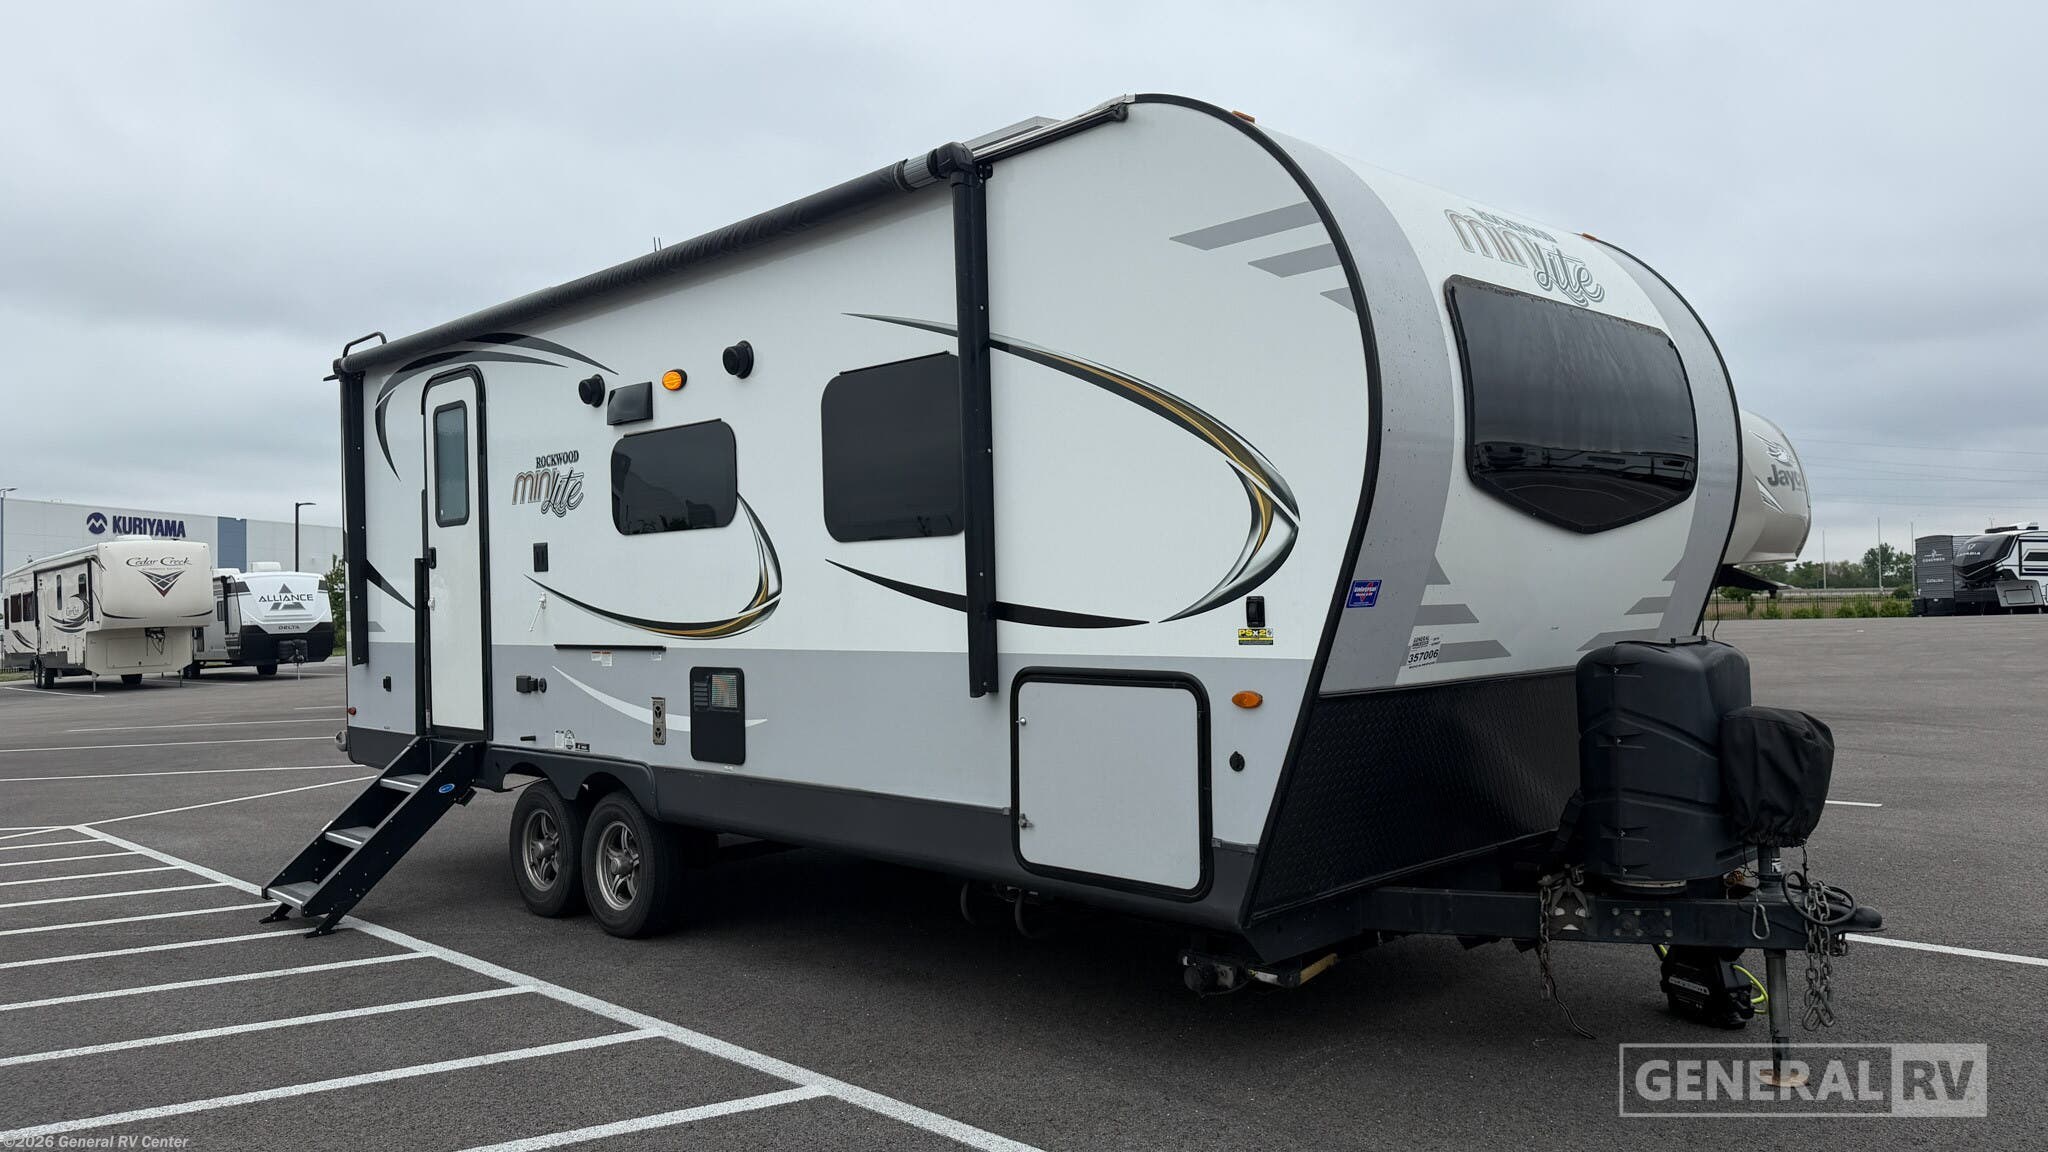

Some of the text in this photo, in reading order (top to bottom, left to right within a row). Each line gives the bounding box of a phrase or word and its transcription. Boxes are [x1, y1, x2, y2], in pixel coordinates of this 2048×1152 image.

[536, 450, 579, 469] ROCKWOOD
[1767, 464, 1805, 491] Jayc
[112, 515, 186, 538] KURIYAMA
[126, 556, 193, 567] Cedar Creek
[258, 594, 314, 603] ALLIANCE
[1408, 649, 1439, 663] 357006
